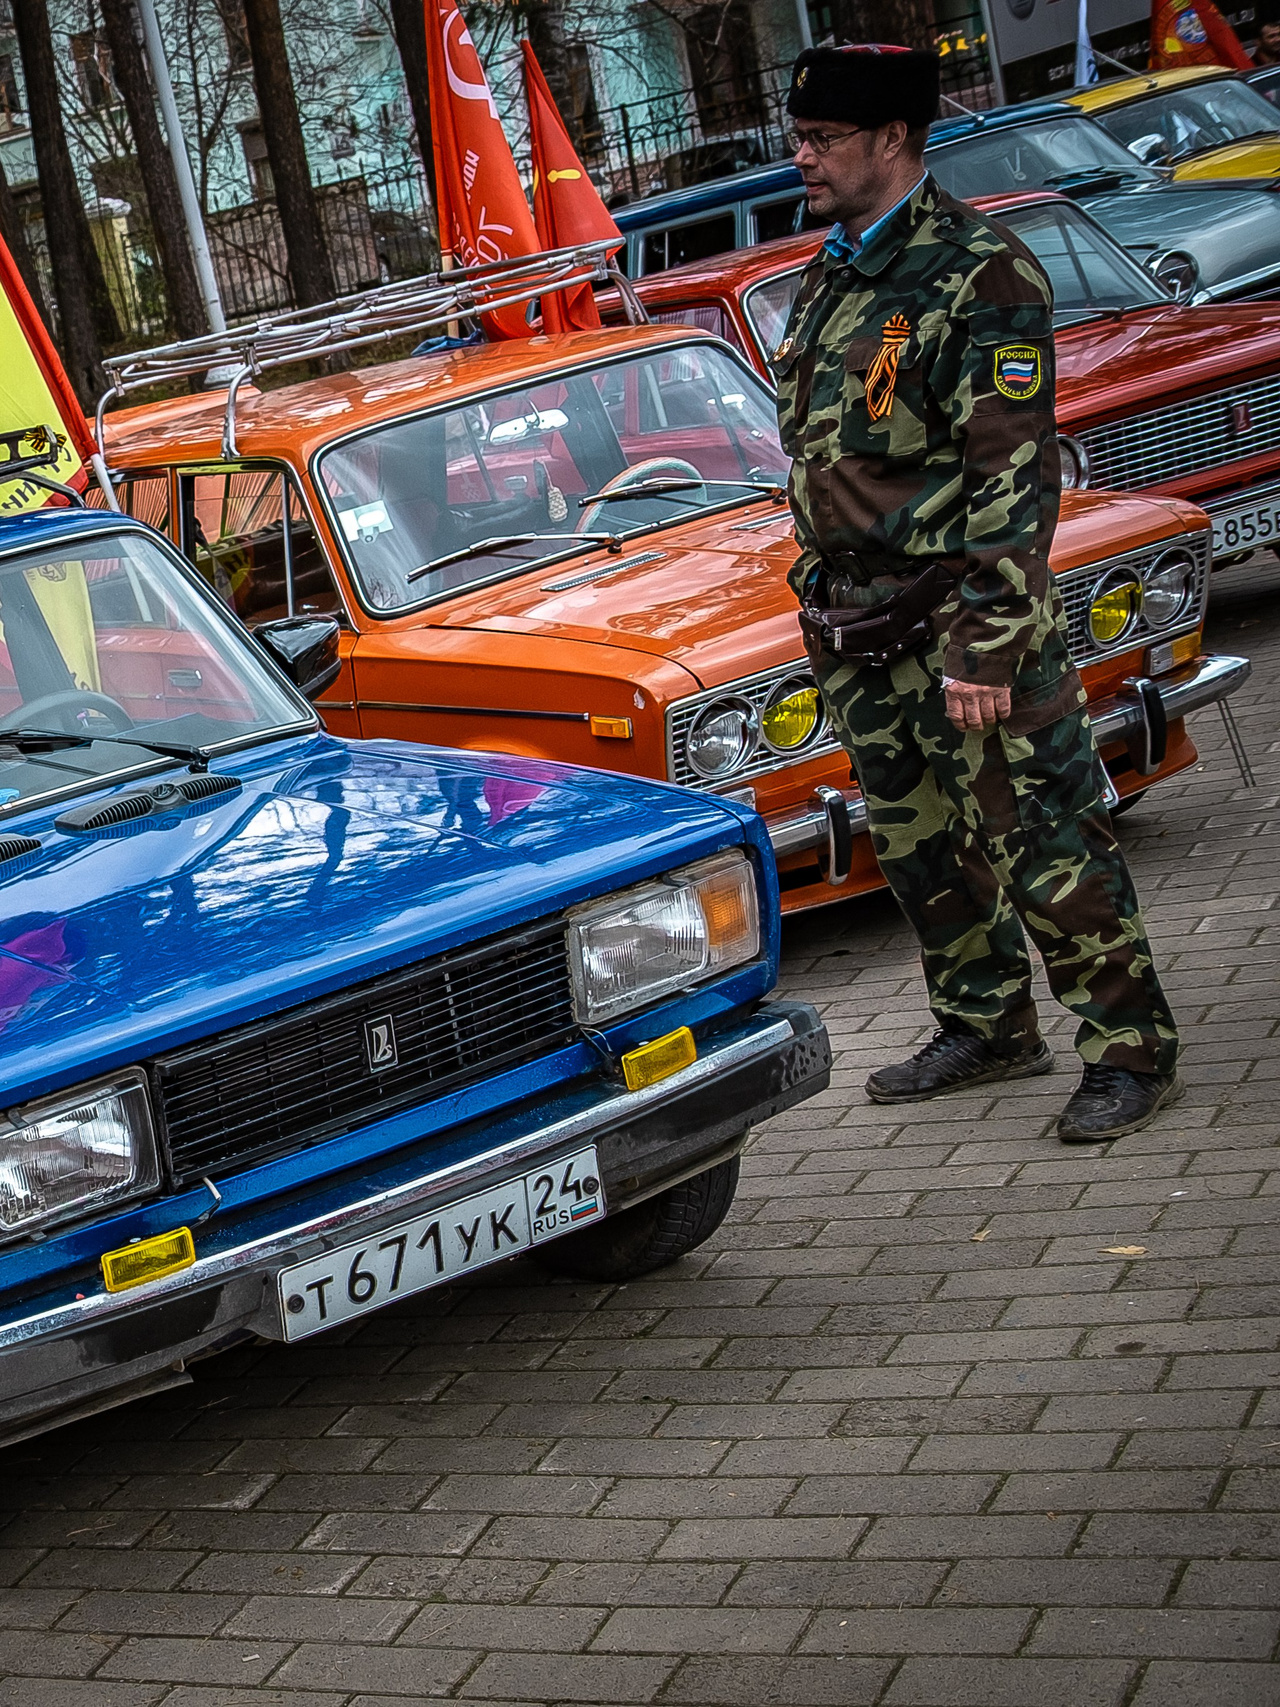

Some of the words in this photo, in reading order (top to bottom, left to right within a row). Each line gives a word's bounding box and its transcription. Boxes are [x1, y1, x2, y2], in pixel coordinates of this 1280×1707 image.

[999, 350, 1036, 360] РОССИЯ
[532, 1159, 583, 1217] 24
[533, 1208, 571, 1237] RUS
